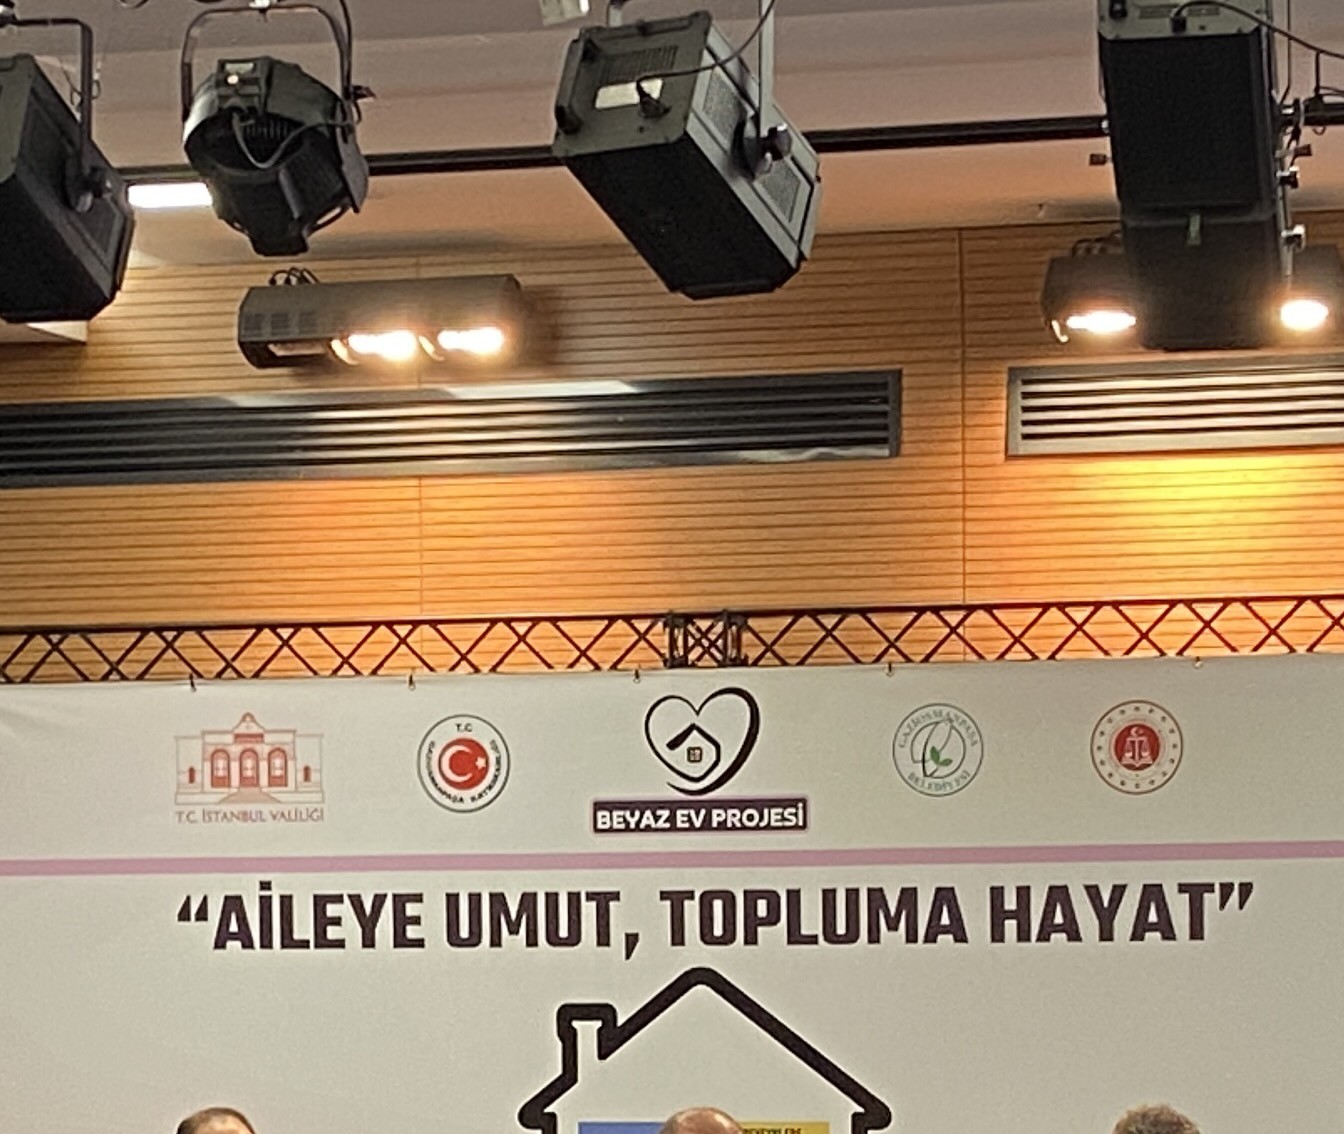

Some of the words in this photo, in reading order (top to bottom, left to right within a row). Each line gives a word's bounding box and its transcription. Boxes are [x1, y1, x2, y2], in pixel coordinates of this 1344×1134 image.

[202, 808, 267, 823] İSTANBUL
[596, 809, 670, 829] BEYAZ
[676, 808, 706, 828] EV
[711, 803, 804, 828] PROJESİ
[177, 880, 426, 950] “AİLEYE
[445, 889, 639, 960] UMUT,
[660, 886, 969, 948] TOPLUMA
[989, 881, 1254, 944] HAYAT”
